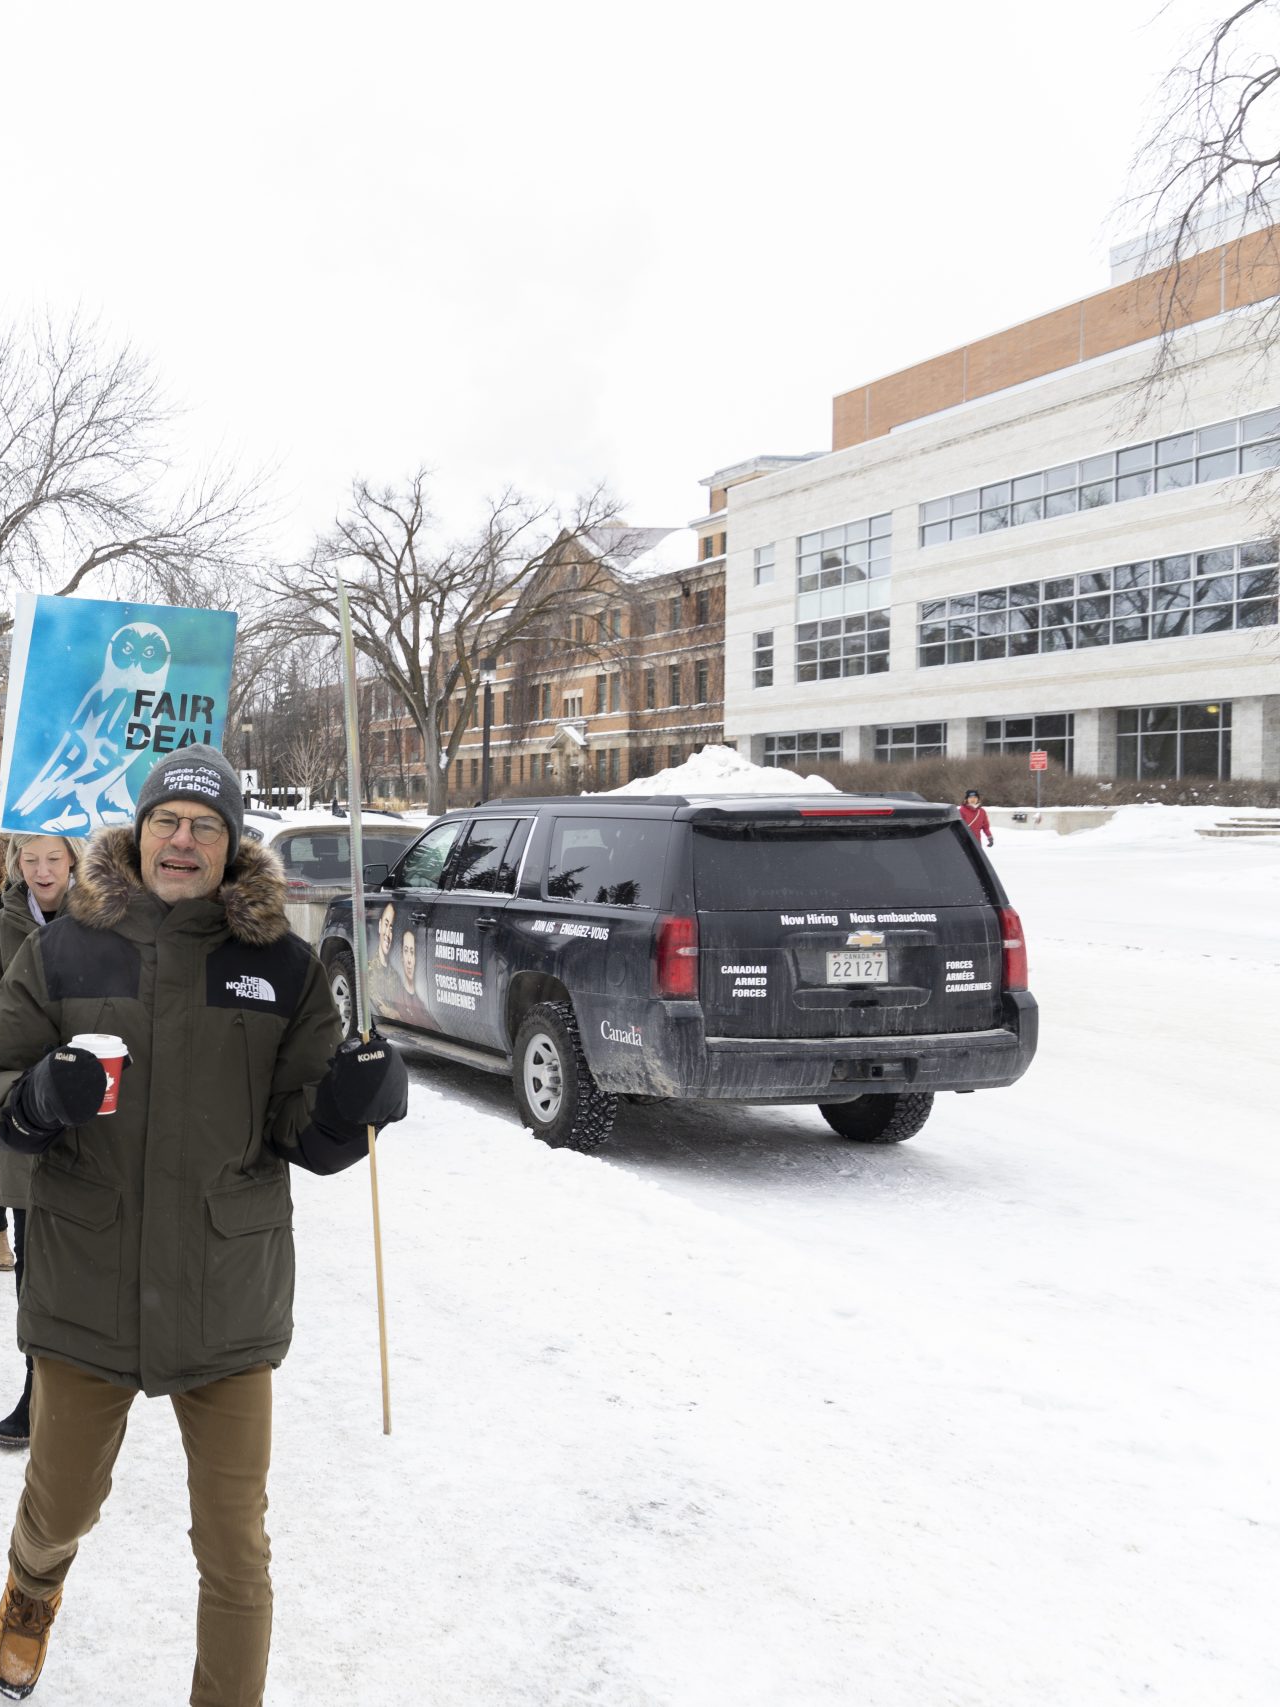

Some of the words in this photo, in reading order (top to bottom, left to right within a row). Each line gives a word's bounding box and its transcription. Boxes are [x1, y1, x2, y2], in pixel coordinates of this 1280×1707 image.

[133, 689, 215, 725] FAIR
[163, 773, 220, 790] Federation
[168, 781, 178, 790] of
[178, 781, 220, 798] Labour
[780, 914, 806, 926] Now
[807, 913, 839, 926] Hiring
[849, 912, 876, 924] Nous
[877, 911, 938, 923] embauchons
[435, 929, 464, 946] CANADIAN
[531, 919, 548, 932] JOIN
[545, 921, 556, 933] US
[559, 922, 610, 941] ENGAGEZ-VOUS
[435, 945, 456, 960] ARMED
[455, 947, 479, 965] FORCES
[720, 965, 768, 974] CANADIAN
[832, 960, 884, 978] 22127
[945, 960, 974, 970] FORCES
[240, 974, 260, 985] THE
[734, 977, 768, 986] ARMED
[945, 970, 975, 981] ARMÉES
[225, 981, 260, 992] NORTH
[434, 973, 458, 991] FORCES
[458, 977, 484, 997] ARMÉES
[945, 982, 992, 993] CANADIENNES
[235, 989, 261, 1000] FACE
[436, 988, 476, 1011] CANADIENNES
[732, 988, 768, 998] FORCES
[600, 1020, 643, 1047] Canada
[357, 1050, 385, 1063] KOMBI
